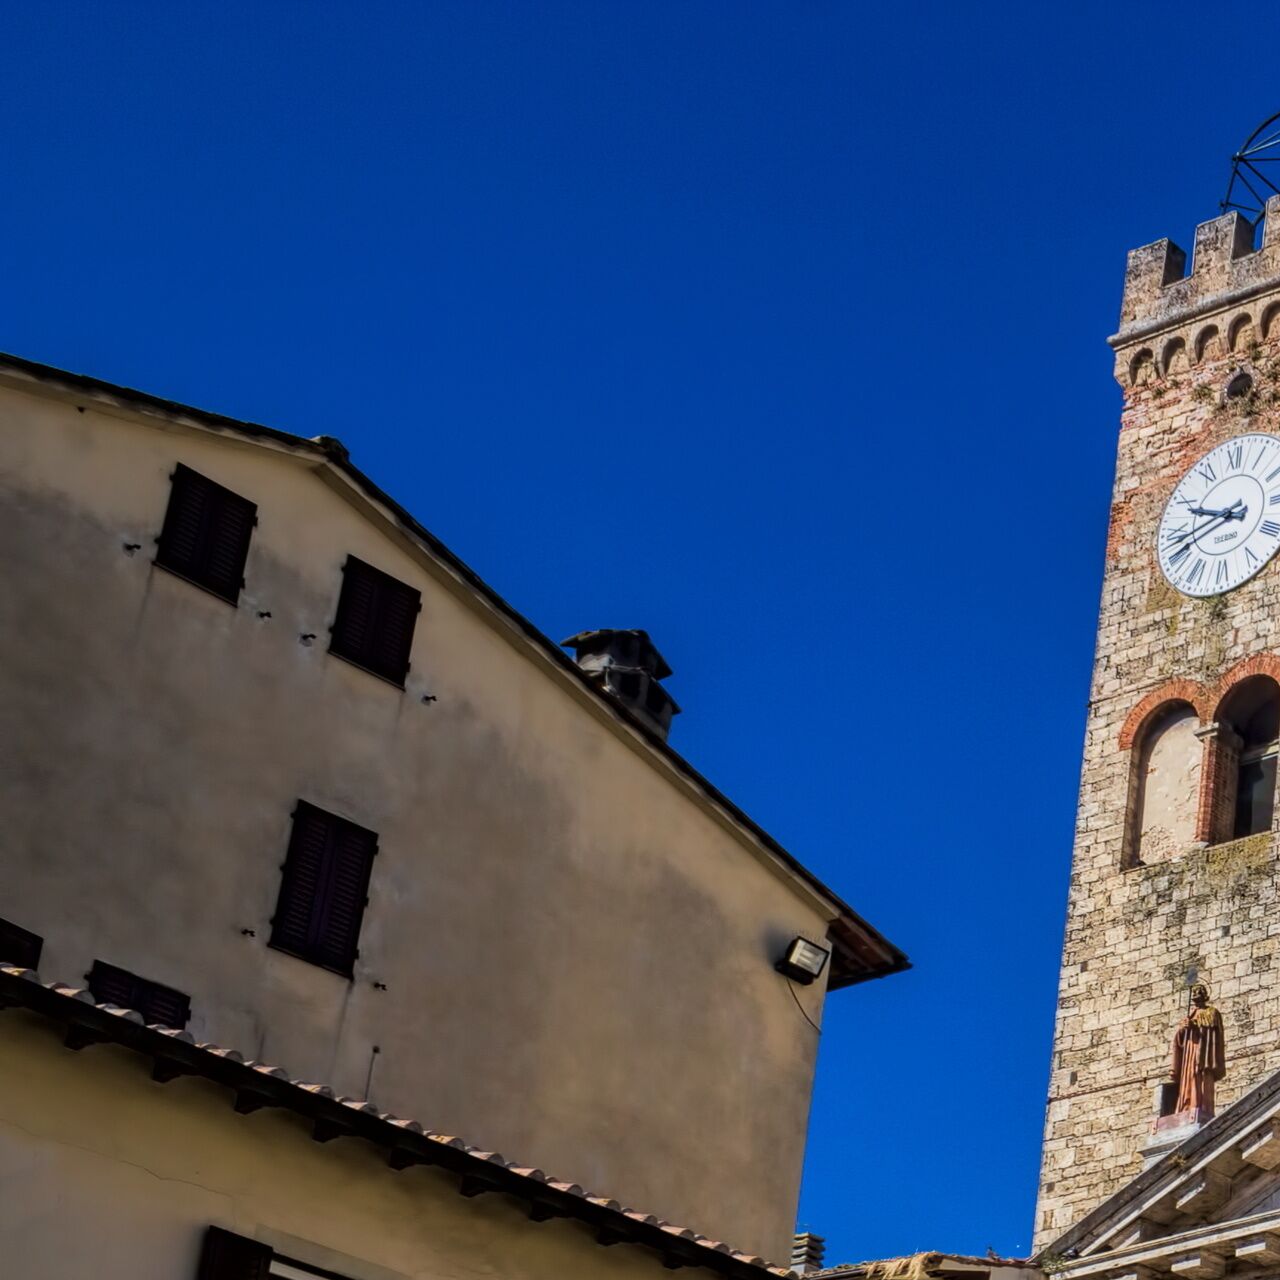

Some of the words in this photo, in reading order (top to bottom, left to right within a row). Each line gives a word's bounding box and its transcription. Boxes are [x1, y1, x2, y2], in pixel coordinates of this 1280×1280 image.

[1226, 445, 1242, 472] XII
[1199, 462, 1216, 488] XI
[1245, 546, 1258, 568] V
[1186, 558, 1207, 586] VII
[1216, 559, 1228, 585] VI
